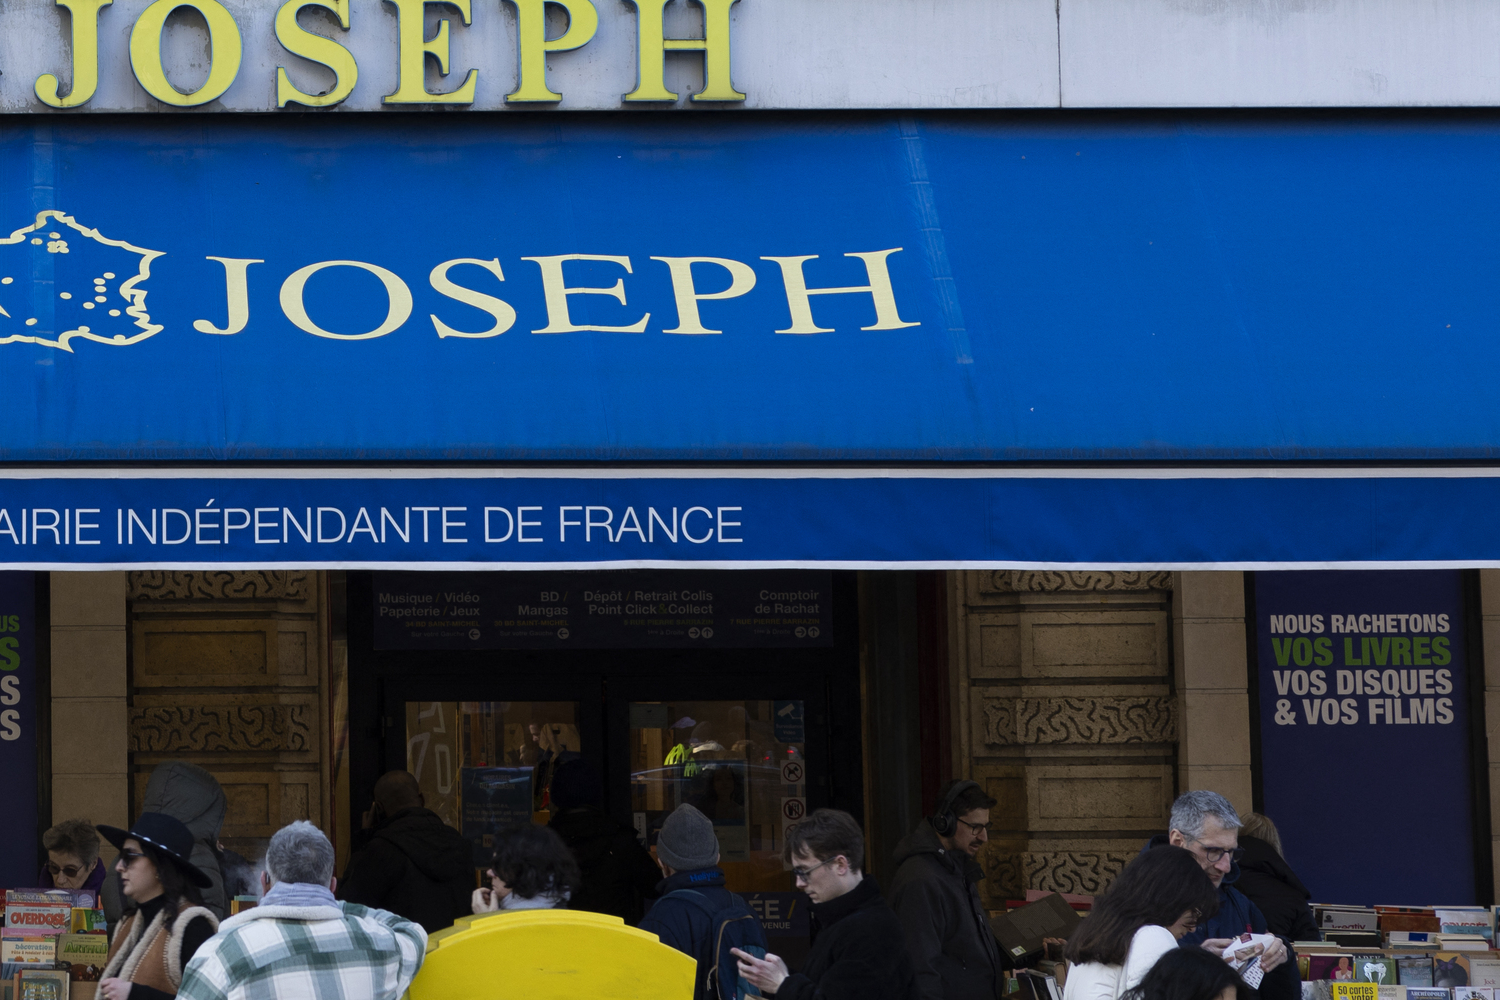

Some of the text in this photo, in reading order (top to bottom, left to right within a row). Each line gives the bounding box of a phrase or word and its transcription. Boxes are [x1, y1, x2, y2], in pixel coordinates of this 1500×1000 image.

[192, 246, 921, 341] JOSEPH
[117, 499, 468, 545] INDÉPENDANTE
[484, 506, 544, 543] DE
[560, 505, 744, 544] FRANCE
[379, 592, 433, 605] Musique
[444, 591, 480, 603] Vidéo
[540, 591, 560, 602] BD
[584, 590, 622, 603] Dépôt
[634, 590, 678, 601] Retrait
[680, 590, 713, 601] Colis
[759, 589, 819, 602] Comptoir
[380, 606, 440, 618] Papeterie
[450, 606, 480, 616] Jeux
[518, 605, 568, 617] Mangas
[589, 604, 622, 615] Point
[754, 603, 819, 614] de Rachat
[428, 620, 480, 628] SAINT-MICHEL
[516, 619, 569, 627] SAINT-MICHEL
[1270, 614, 1451, 634] NOUS RACHETONS
[1271, 636, 1451, 666] VOS LIVRES
[1272, 669, 1453, 698] VOS DISQUES
[1274, 698, 1454, 725] & VOS FILMS
[10, 912, 66, 926] OVERDOSE
[1337, 985, 1348, 994] 50
[1349, 986, 1374, 994] cartes
